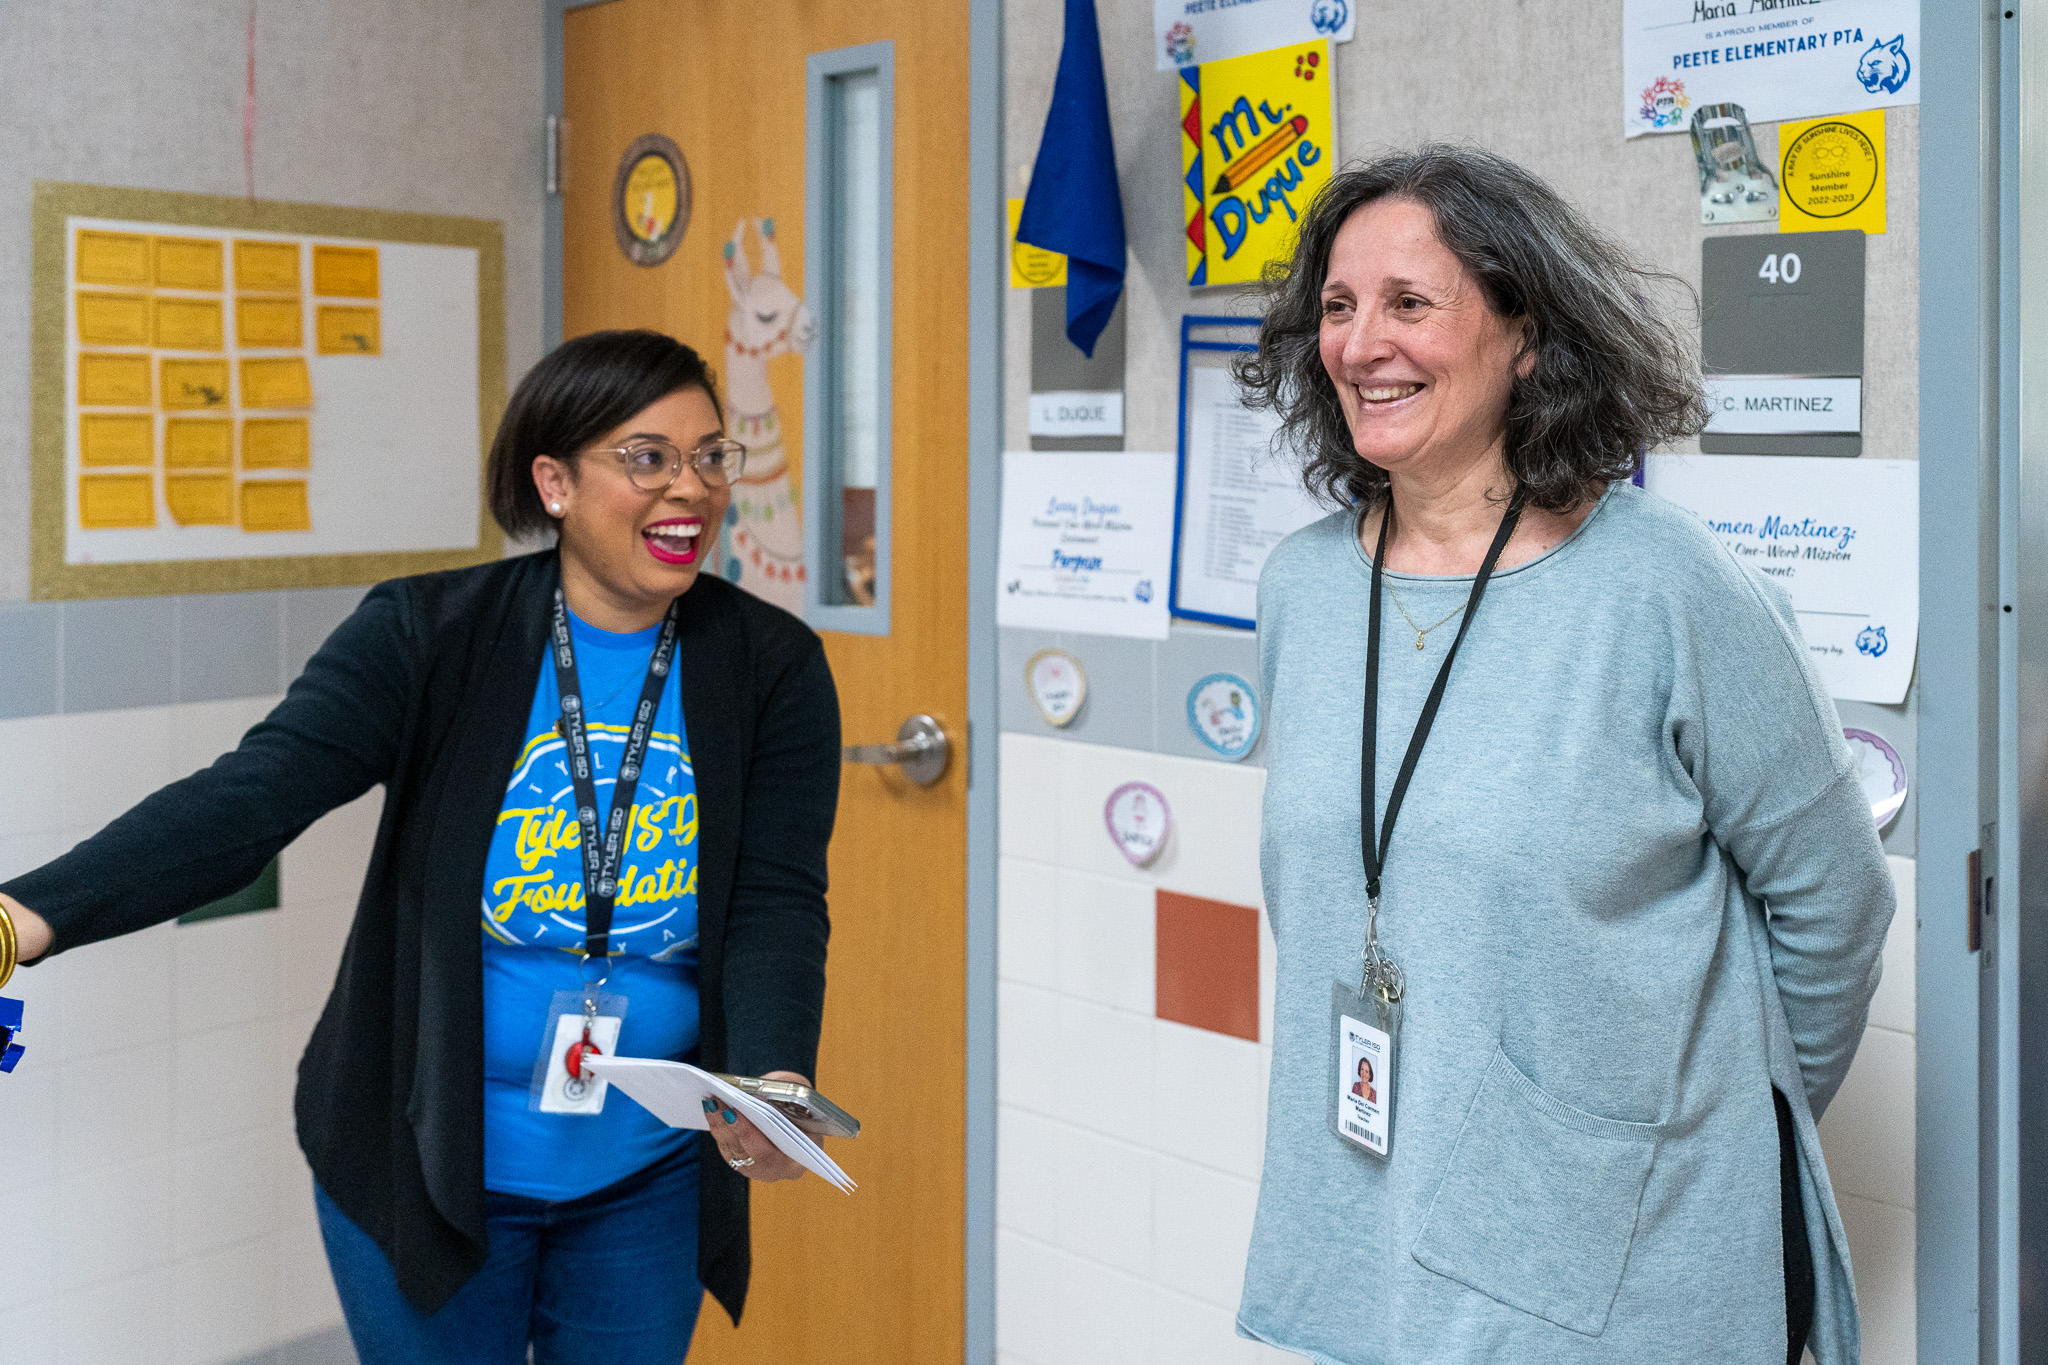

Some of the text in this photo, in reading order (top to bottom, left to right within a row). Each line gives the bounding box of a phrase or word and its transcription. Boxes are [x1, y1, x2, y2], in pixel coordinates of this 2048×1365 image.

[1723, 27, 1756, 37] PROUD
[1758, 20, 1798, 32] MEMBER
[1802, 16, 1815, 25] OF
[1673, 28, 1864, 70] PEETE ELEMENTARY PTA
[1803, 126, 1837, 144] SUNSHINE
[1839, 128, 1860, 140] LIVES
[1809, 170, 1851, 180] Sunshine
[1811, 183, 1849, 192] Member
[1210, 139, 1321, 261] Duque
[1808, 194, 1855, 205] 2022-2023
[1758, 252, 1802, 284] 40
[1723, 397, 1834, 412] C. MARTINEZ
[1759, 514, 1857, 550] Martinez:
[1802, 546, 1852, 561] Mission
[554, 602, 569, 645] TYLER
[569, 710, 589, 779] TYLER ISD
[626, 699, 652, 763] TYLER ISD
[497, 804, 582, 871] Tyle
[586, 823, 600, 870] TYLER
[601, 807, 624, 877] TYLER ISD
